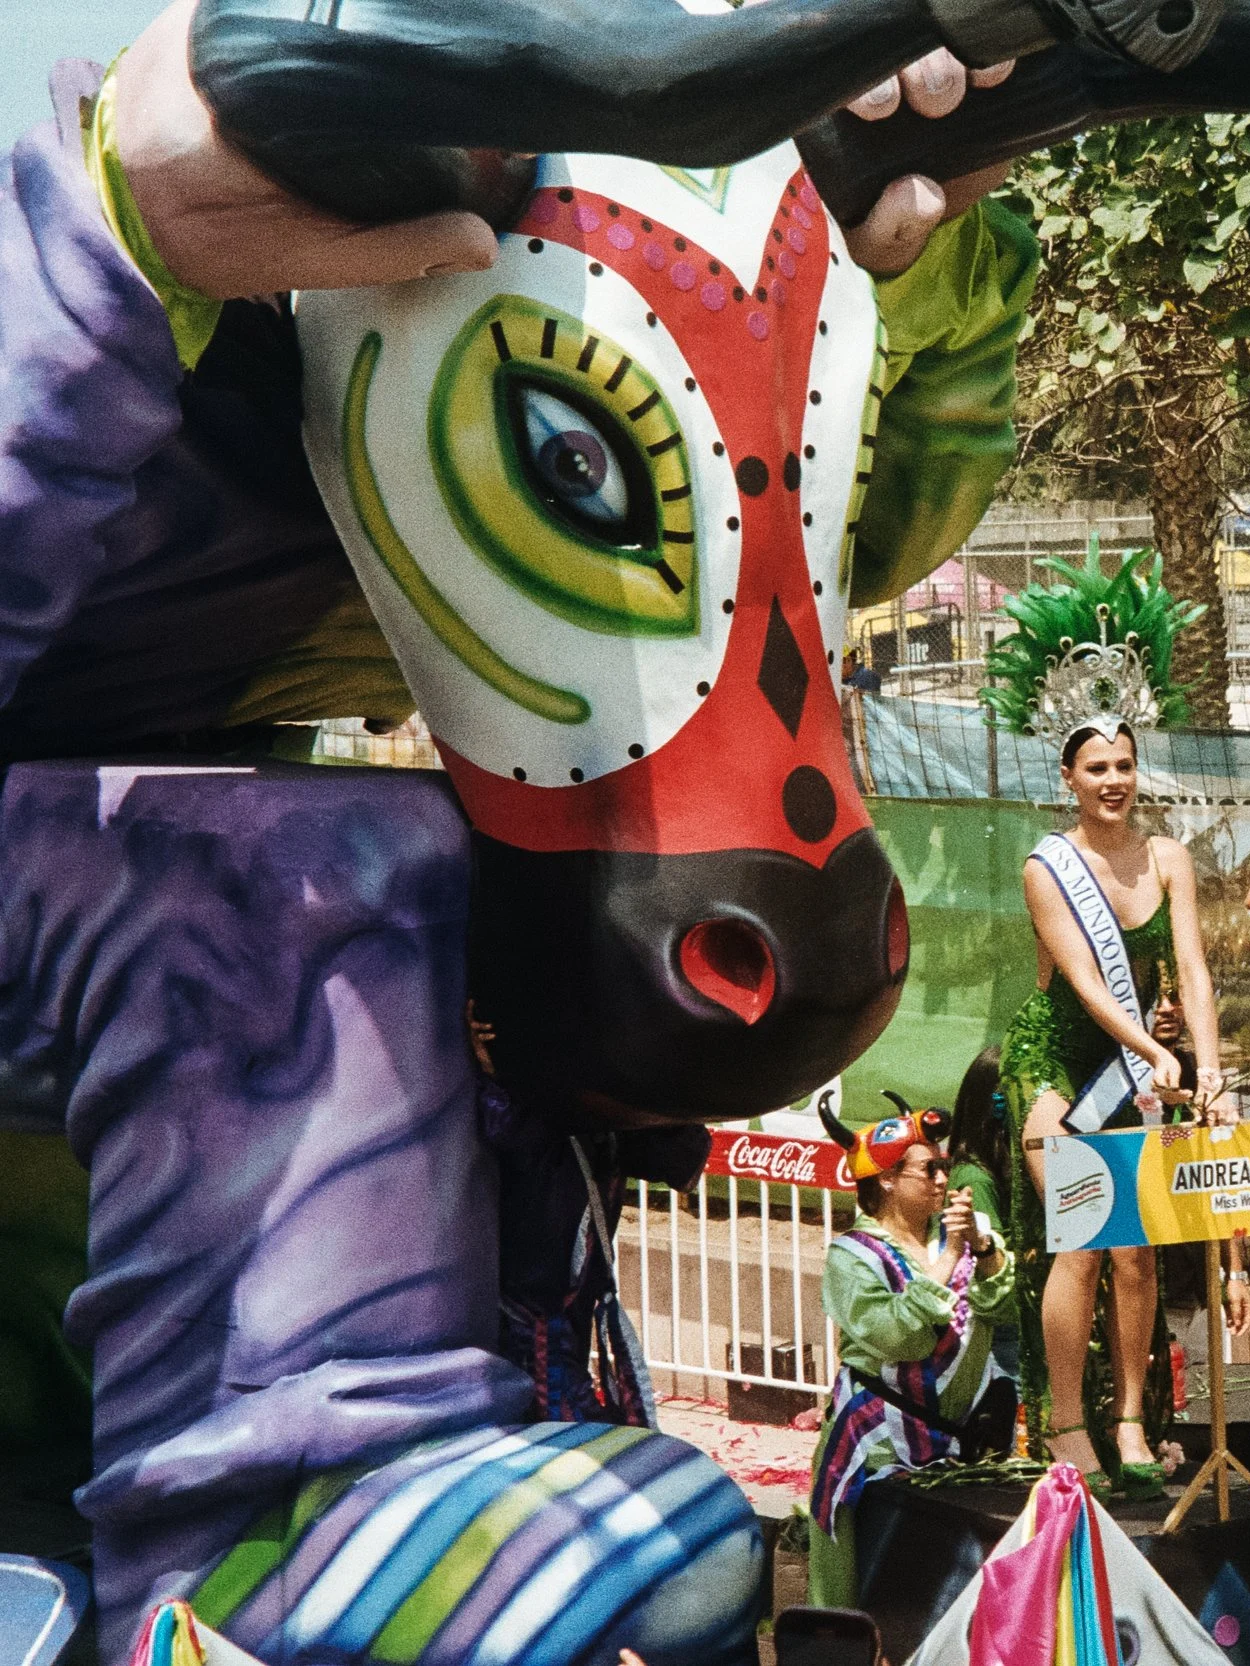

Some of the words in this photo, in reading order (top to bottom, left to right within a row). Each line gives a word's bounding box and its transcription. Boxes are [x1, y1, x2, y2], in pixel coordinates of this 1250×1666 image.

[1066, 875, 1121, 962] MUNDO
[728, 1136, 820, 1182] Coca-Cola
[1175, 1161, 1250, 1191] ANDREA
[1214, 1195, 1237, 1209] Miss
